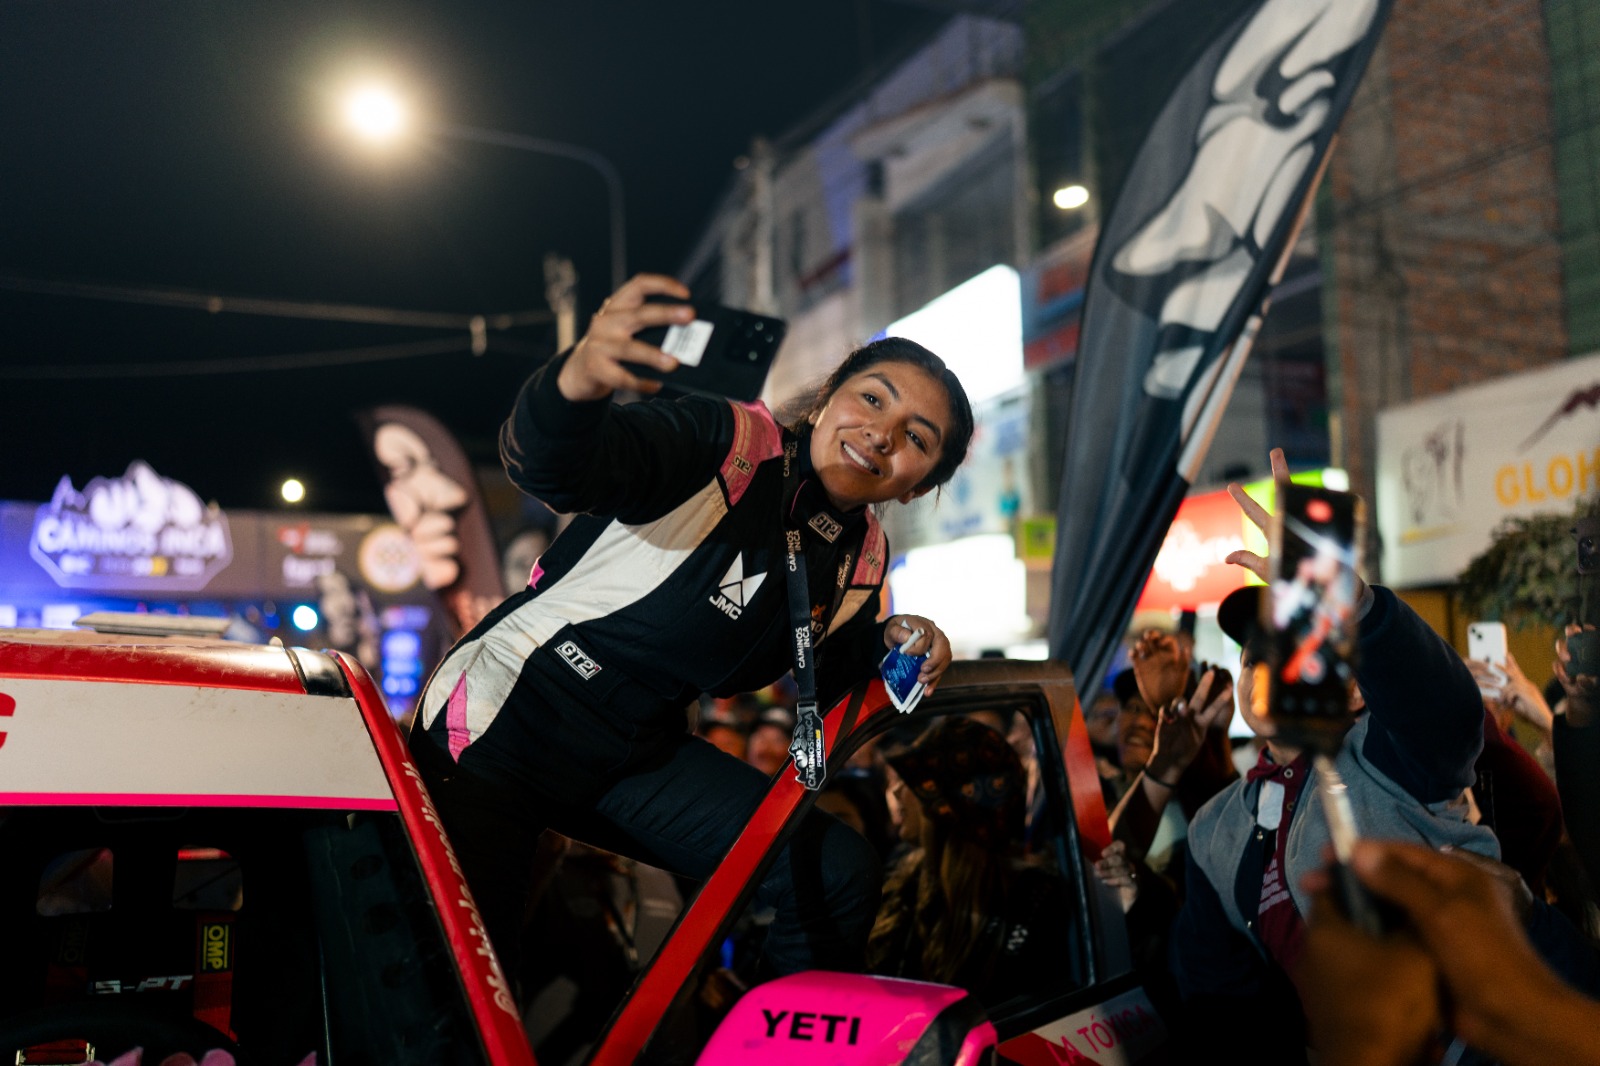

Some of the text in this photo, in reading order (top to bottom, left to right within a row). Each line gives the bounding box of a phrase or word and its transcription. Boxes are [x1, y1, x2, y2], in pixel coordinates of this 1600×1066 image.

[793, 529, 801, 551] INCA
[812, 513, 841, 540] GT2i
[786, 530, 797, 572] CAMINOS
[708, 595, 742, 621] JMC
[795, 626, 806, 668] CAMINOS
[802, 625, 810, 648] INCA
[560, 641, 601, 679] GT2i
[207, 925, 225, 970] OMP
[762, 1009, 861, 1046] YETI
[1045, 1012, 1157, 1066] LA TÓXICA
